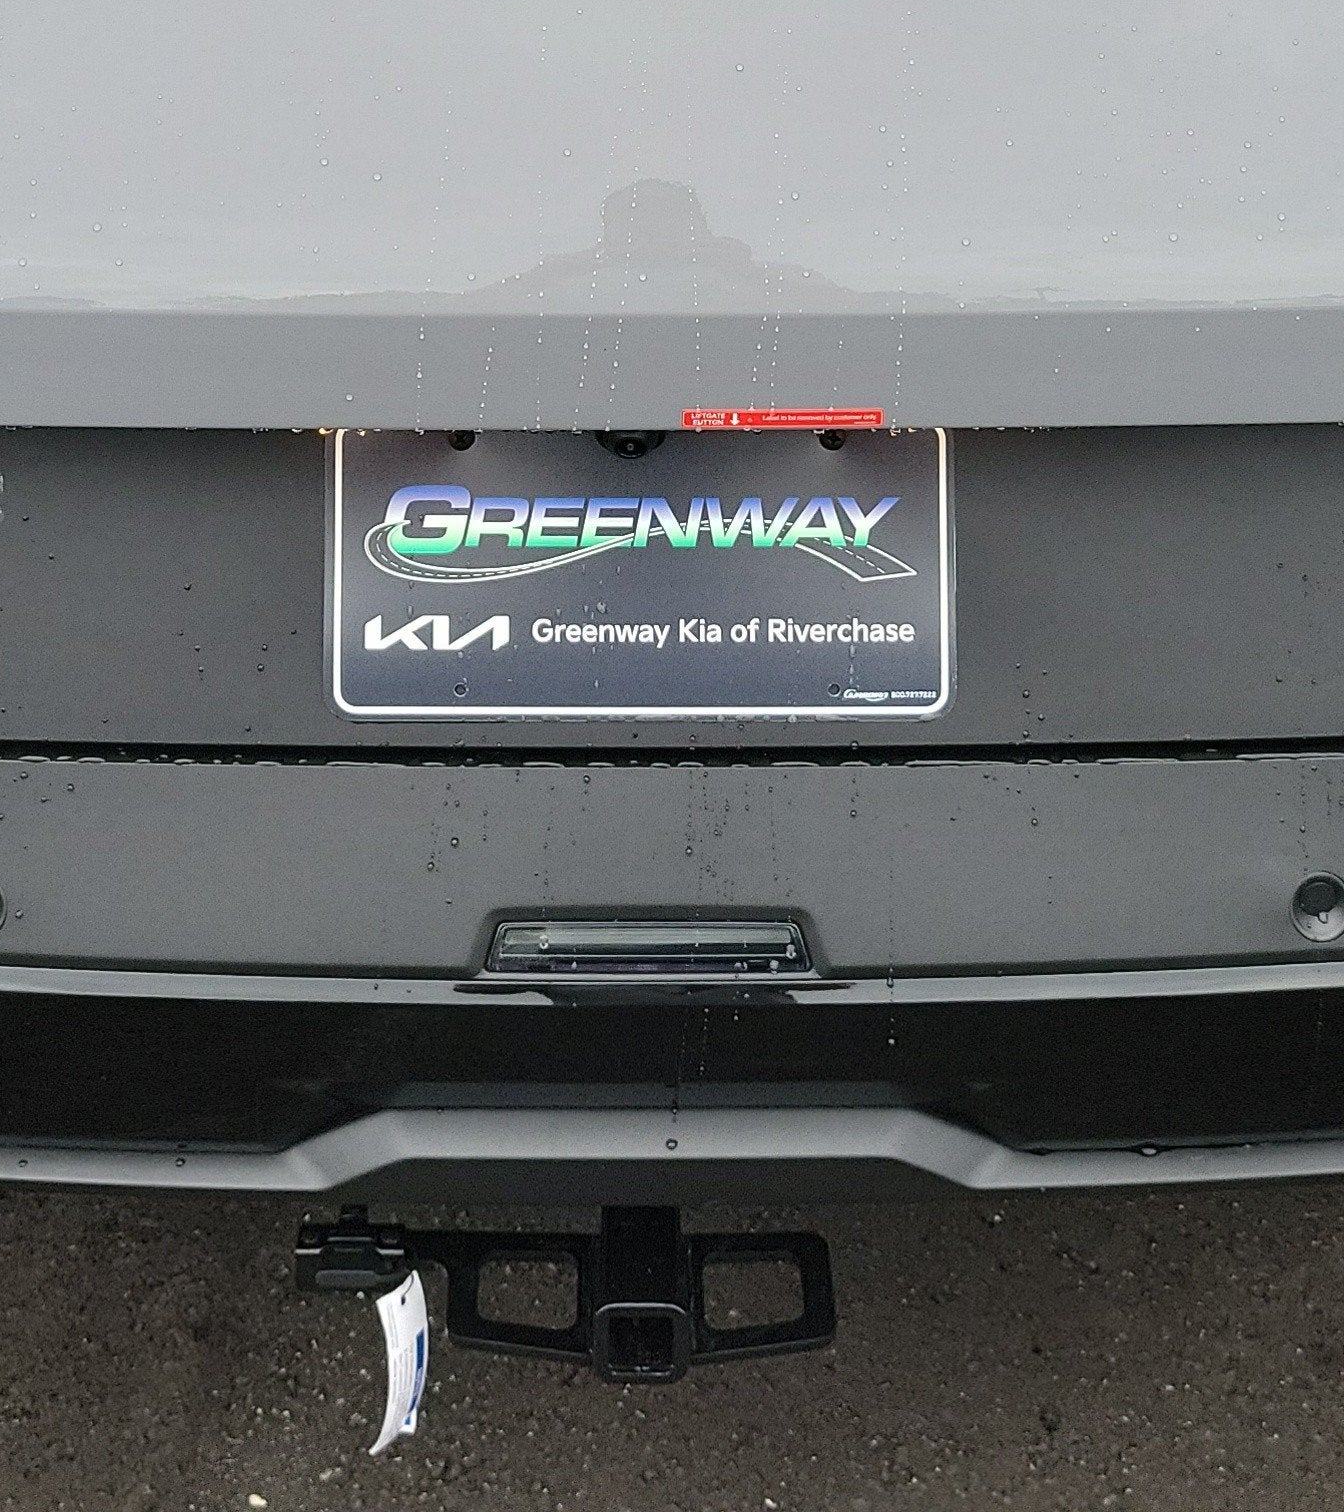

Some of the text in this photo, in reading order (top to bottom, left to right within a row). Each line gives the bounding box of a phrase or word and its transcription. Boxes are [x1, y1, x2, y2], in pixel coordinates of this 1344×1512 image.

[385, 485, 902, 555] GREENWAY
[364, 614, 916, 651] KIA Greenway Kia of Riverchase
